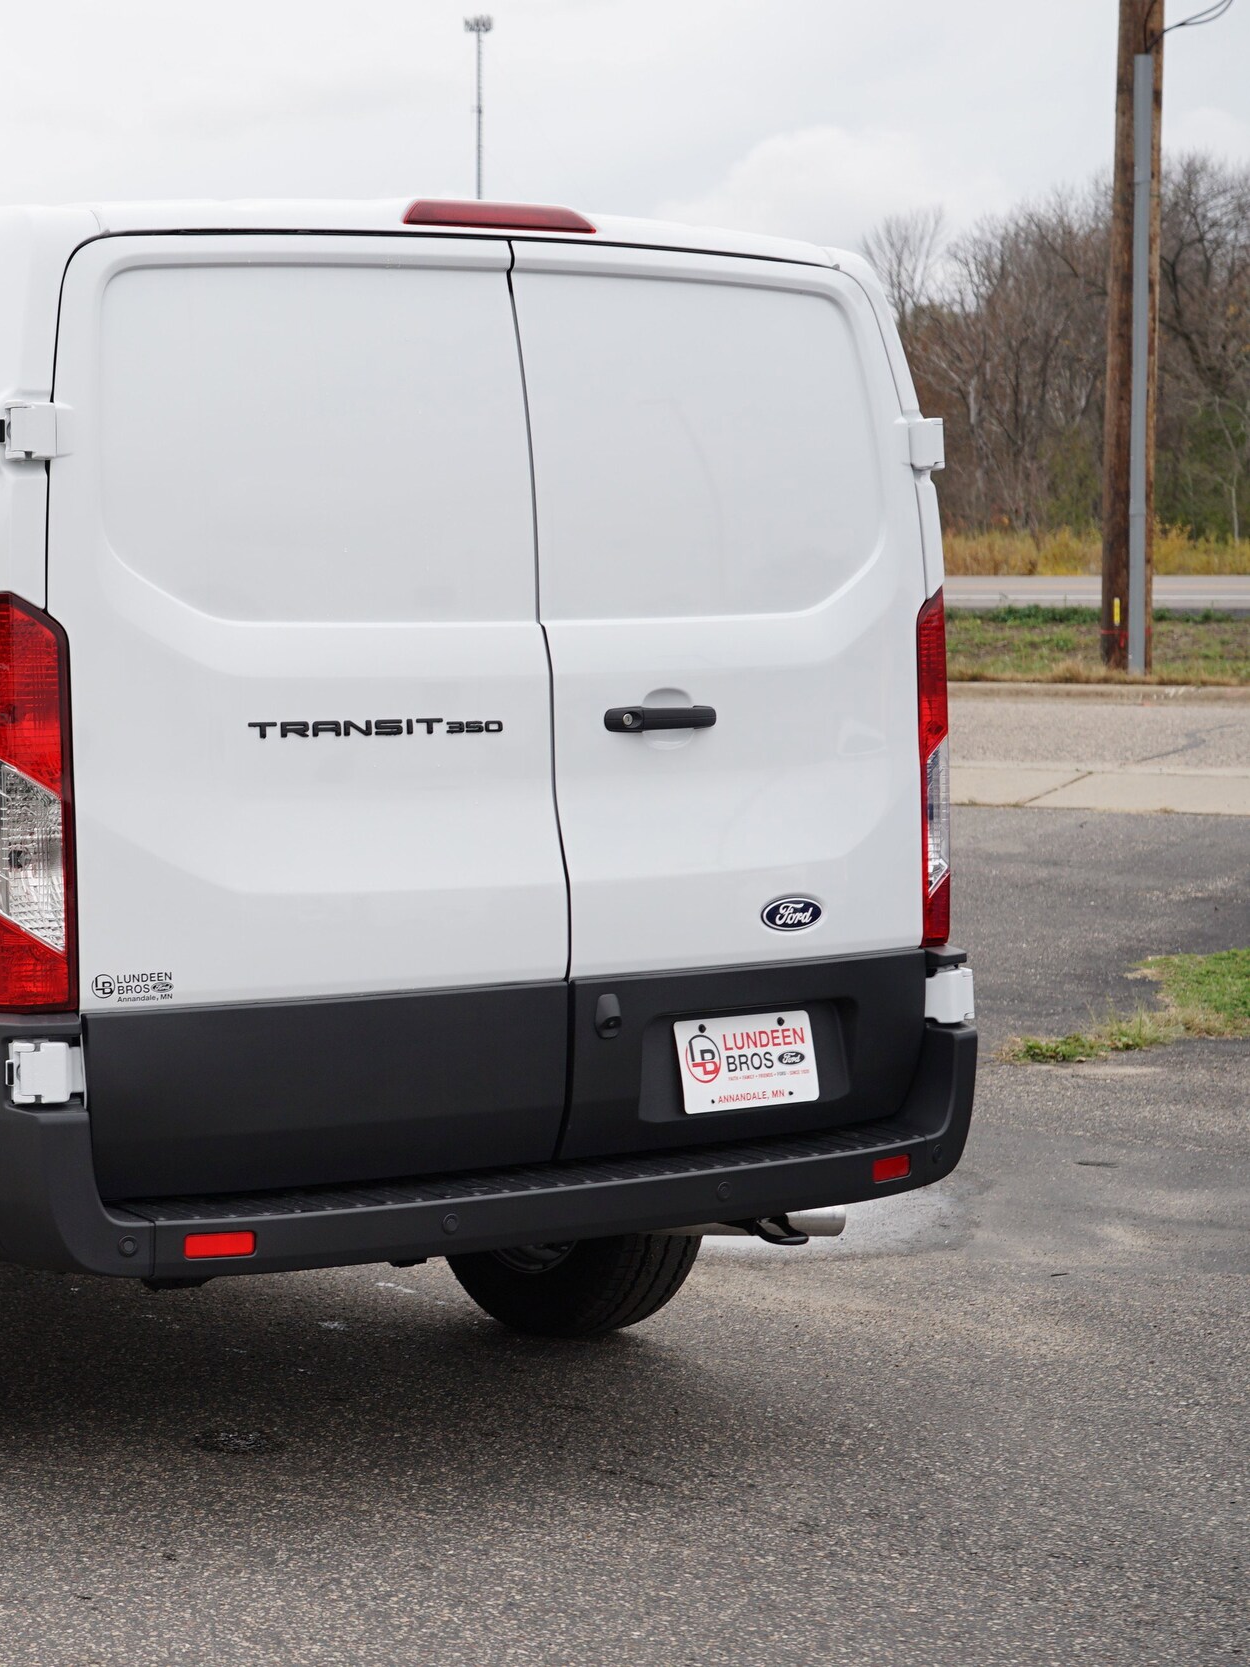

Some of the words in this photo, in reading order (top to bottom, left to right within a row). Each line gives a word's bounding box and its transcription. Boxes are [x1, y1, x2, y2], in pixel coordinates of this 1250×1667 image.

[247, 717, 444, 739] TRANSIT
[775, 903, 813, 925] Ford
[117, 972, 172, 984] LUNDEEN
[117, 984, 150, 995] BROS
[723, 1027, 805, 1051] LUNDEEN
[726, 1051, 774, 1073] BROS
[718, 1090, 770, 1104] ANNANDALE,
[771, 1089, 785, 1098] MN
